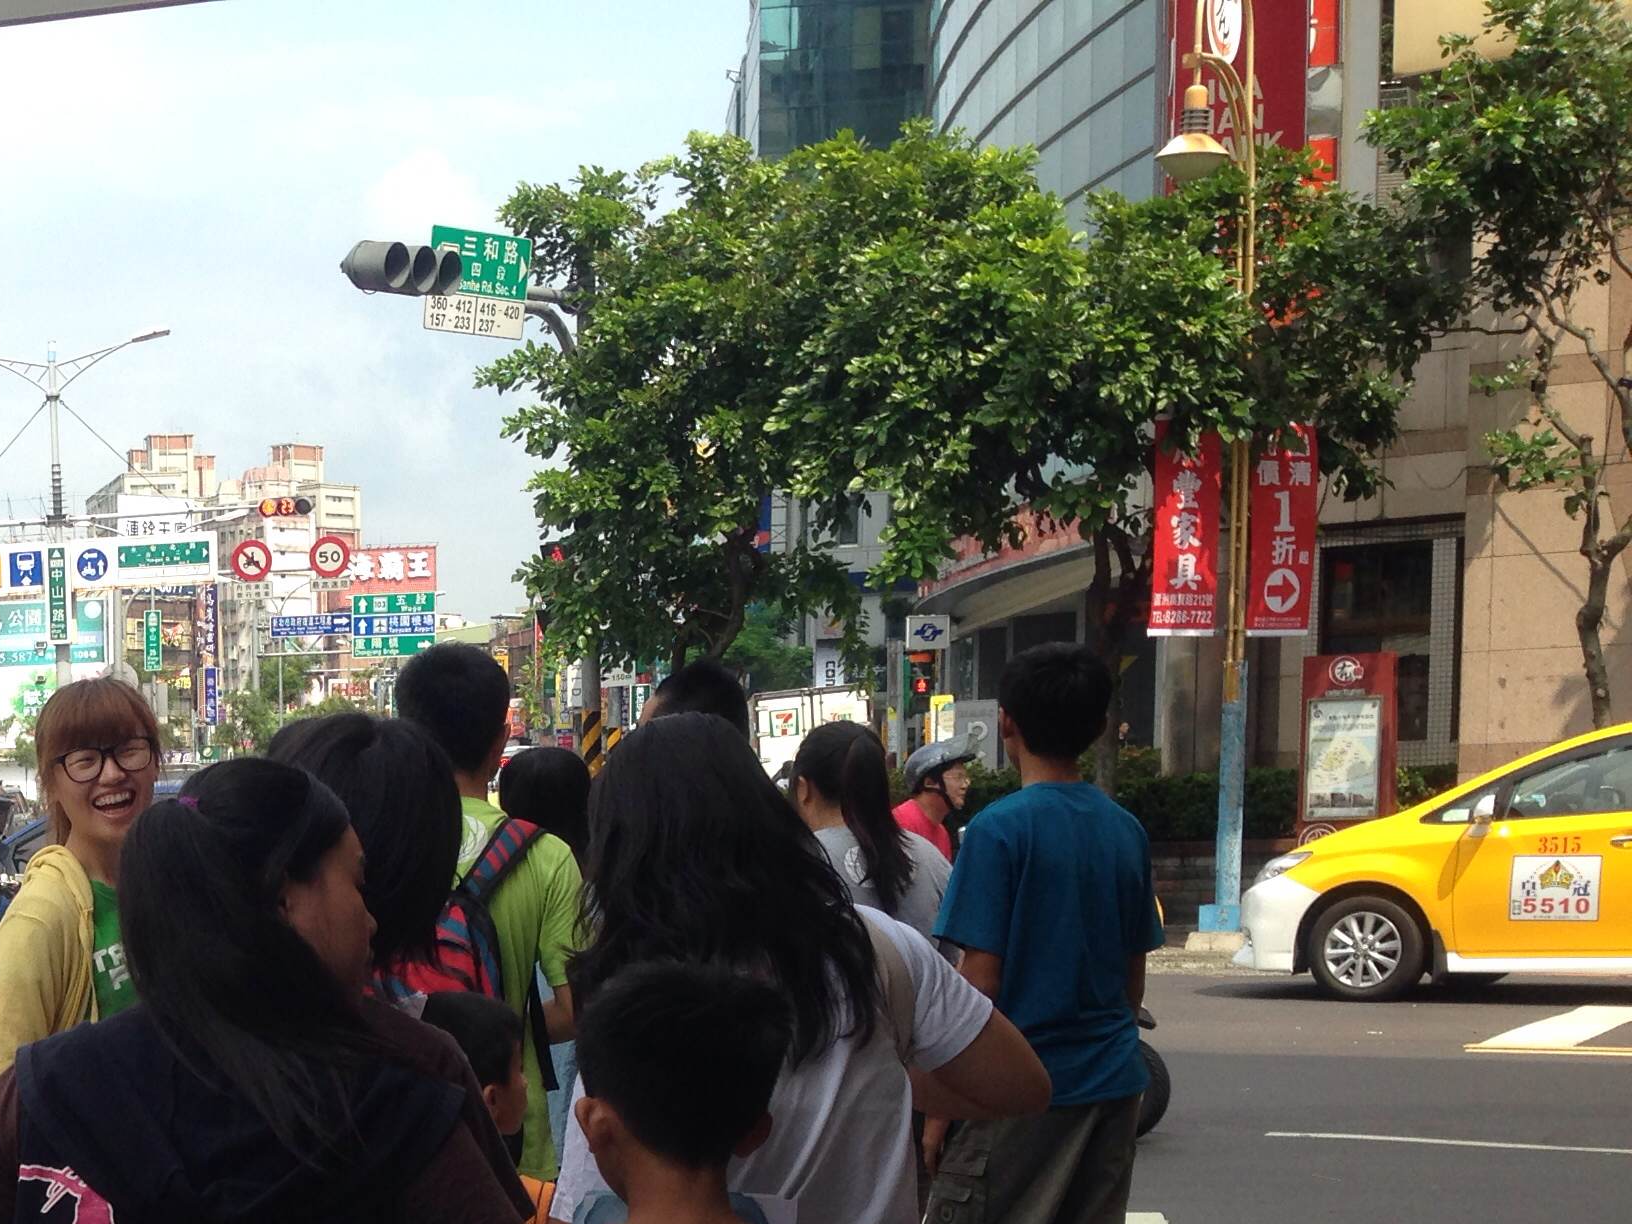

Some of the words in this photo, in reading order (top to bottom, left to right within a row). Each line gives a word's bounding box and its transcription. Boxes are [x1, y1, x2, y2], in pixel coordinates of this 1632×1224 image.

[461, 236, 519, 265] 三和路
[318, 551, 341, 564] 50
[348, 551, 432, 581] 海霸王
[51, 568, 65, 623] 中山一路
[388, 615, 434, 627] 桃園機場
[1537, 836, 1582, 854] 3515
[1523, 897, 1590, 914] 5510
